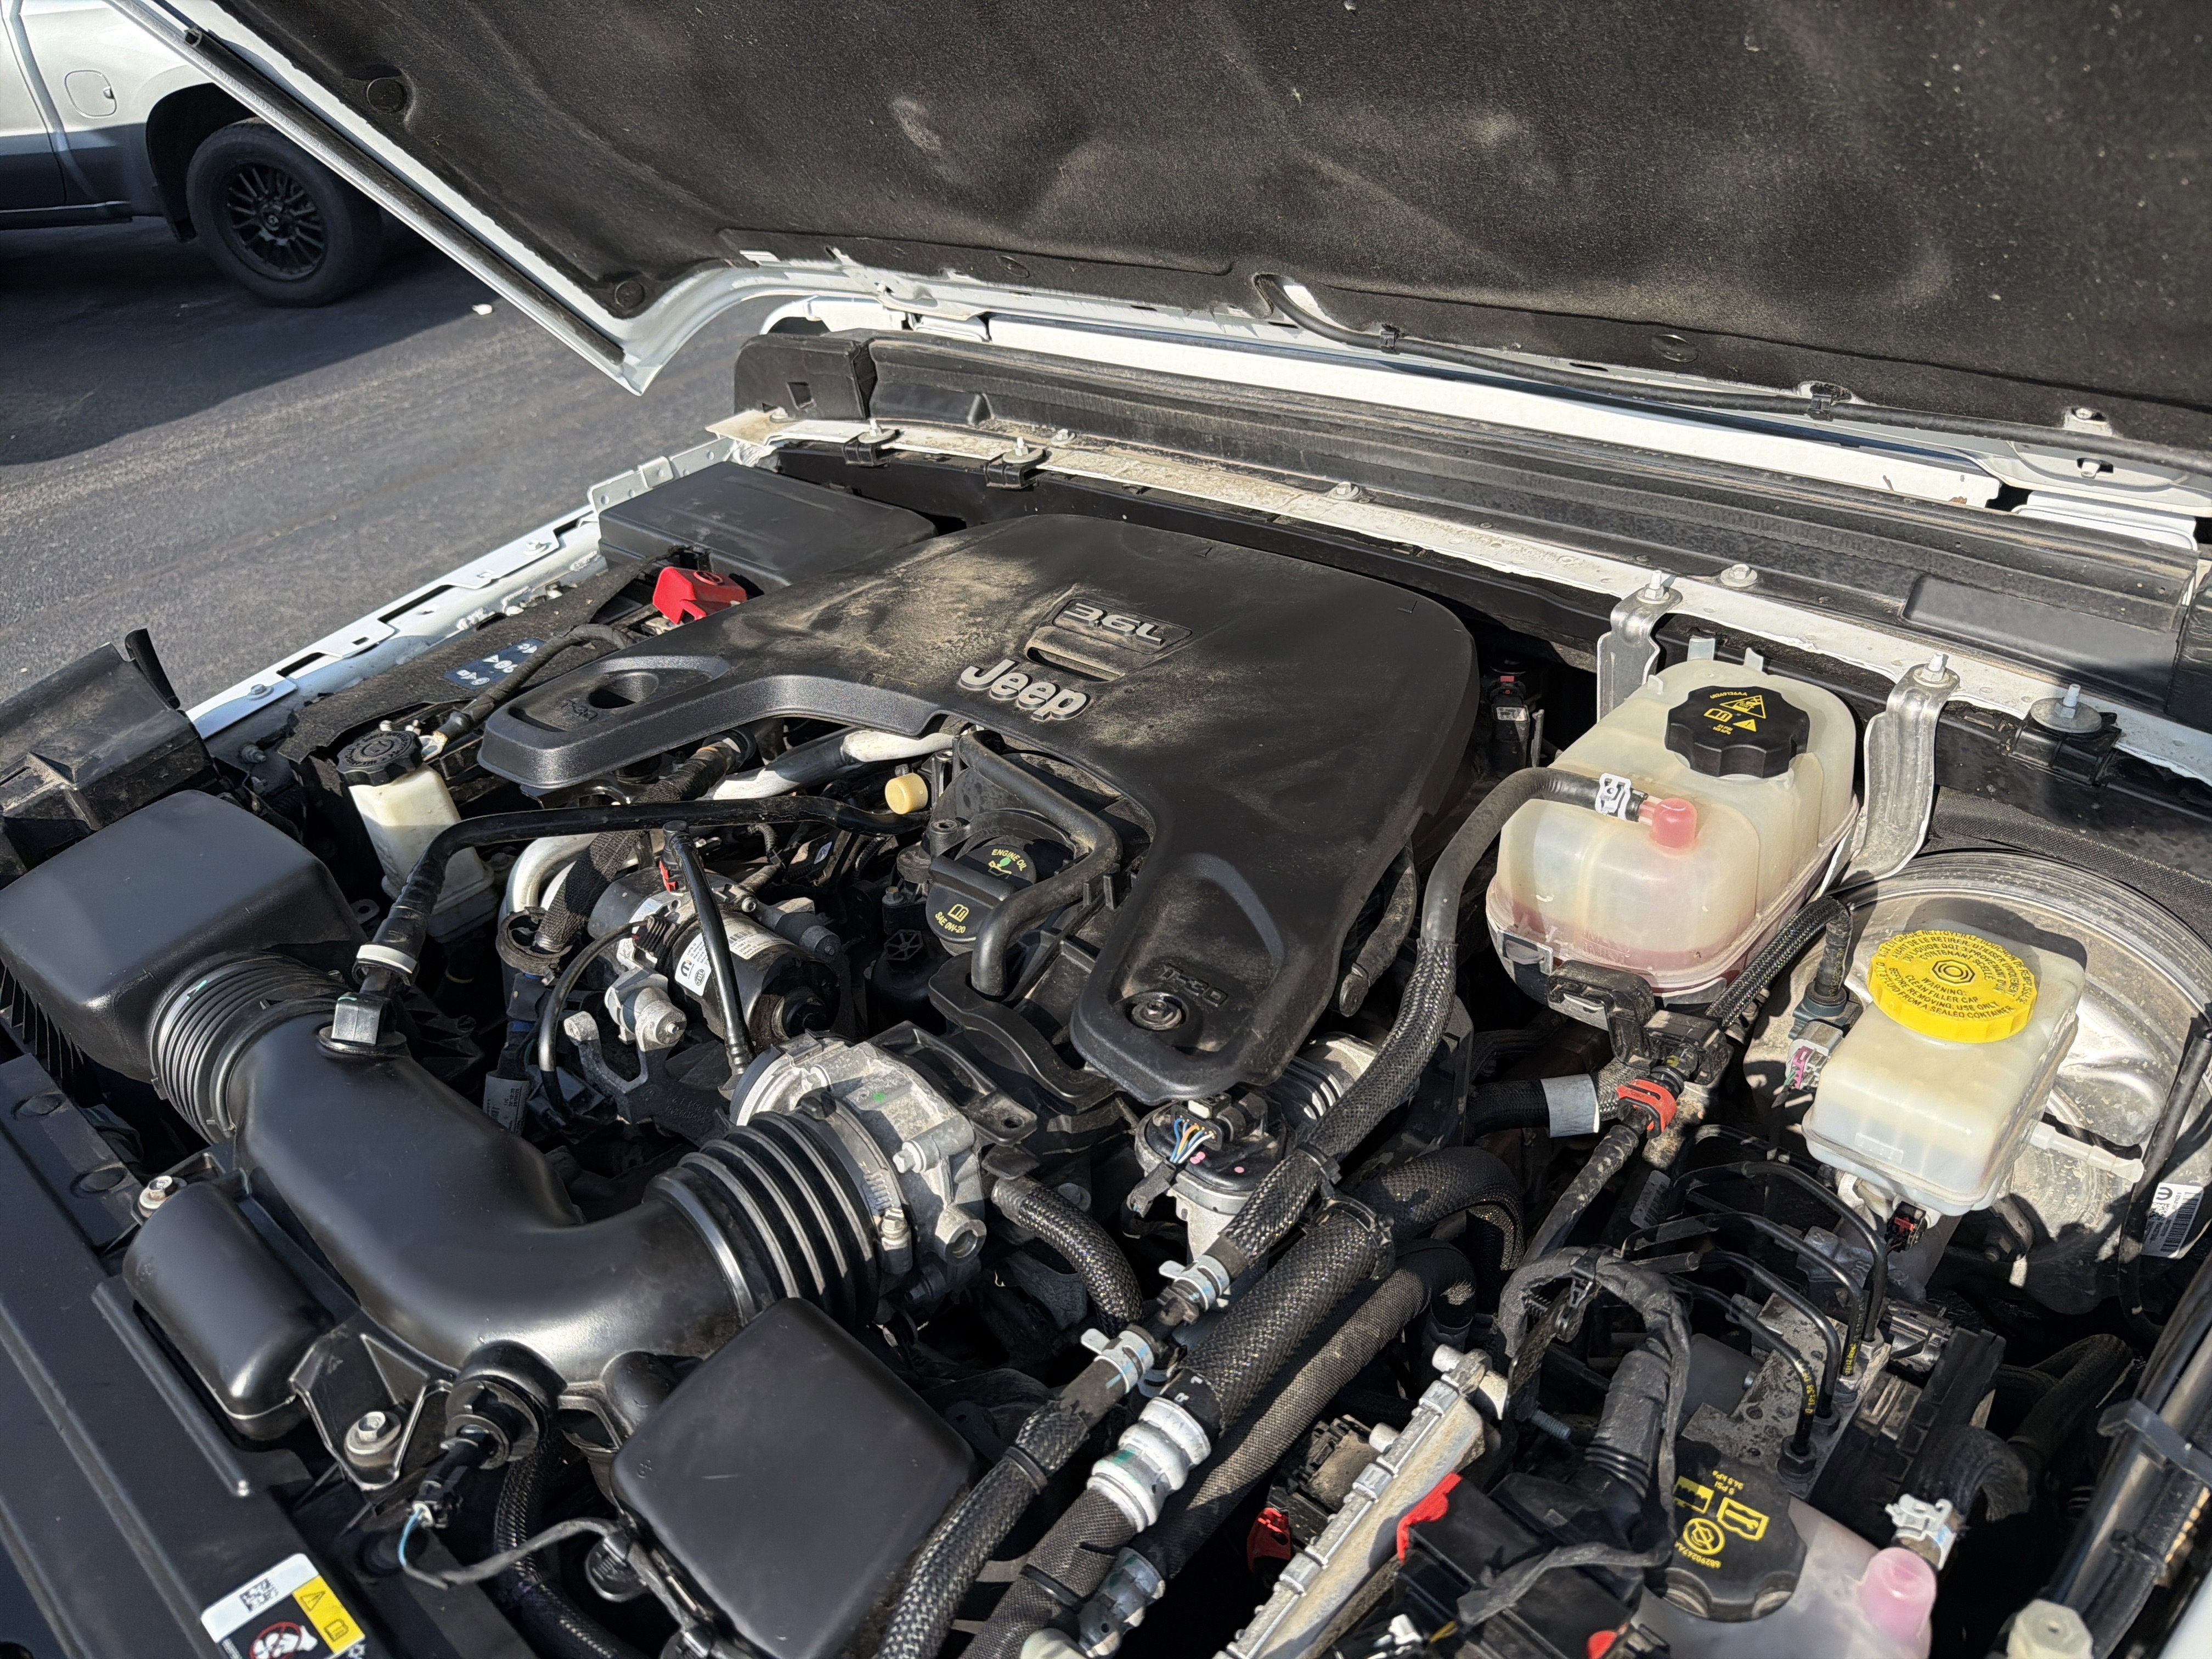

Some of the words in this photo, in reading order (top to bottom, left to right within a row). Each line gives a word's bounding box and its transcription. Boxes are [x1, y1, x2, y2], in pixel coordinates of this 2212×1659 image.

[1063, 603, 1164, 646] 3.6L
[960, 659, 1091, 721] Jeep
[991, 849, 1020, 861] ENGINE
[1017, 859, 1027, 871] OIL
[935, 911, 947, 926] SAE
[944, 922, 966, 933] 0W-20
[1908, 939, 1920, 947] DE
[1972, 944, 2006, 962] UTILISER
[1912, 943, 1939, 955] LIQUIDE
[1919, 949, 1973, 960] CONTENANT
[1980, 940, 2018, 961] BOUCHON
[1905, 975, 1928, 992] CLEAN
[1928, 990, 1958, 1003] FILLER
[1898, 991, 1922, 1006] FROM
[1930, 1006, 1965, 1018] SEALED
[1966, 1005, 2015, 1019] CONTAINER
[1977, 1001, 2000, 1011] ONLY
[1714, 1481, 1729, 1493] PSI
